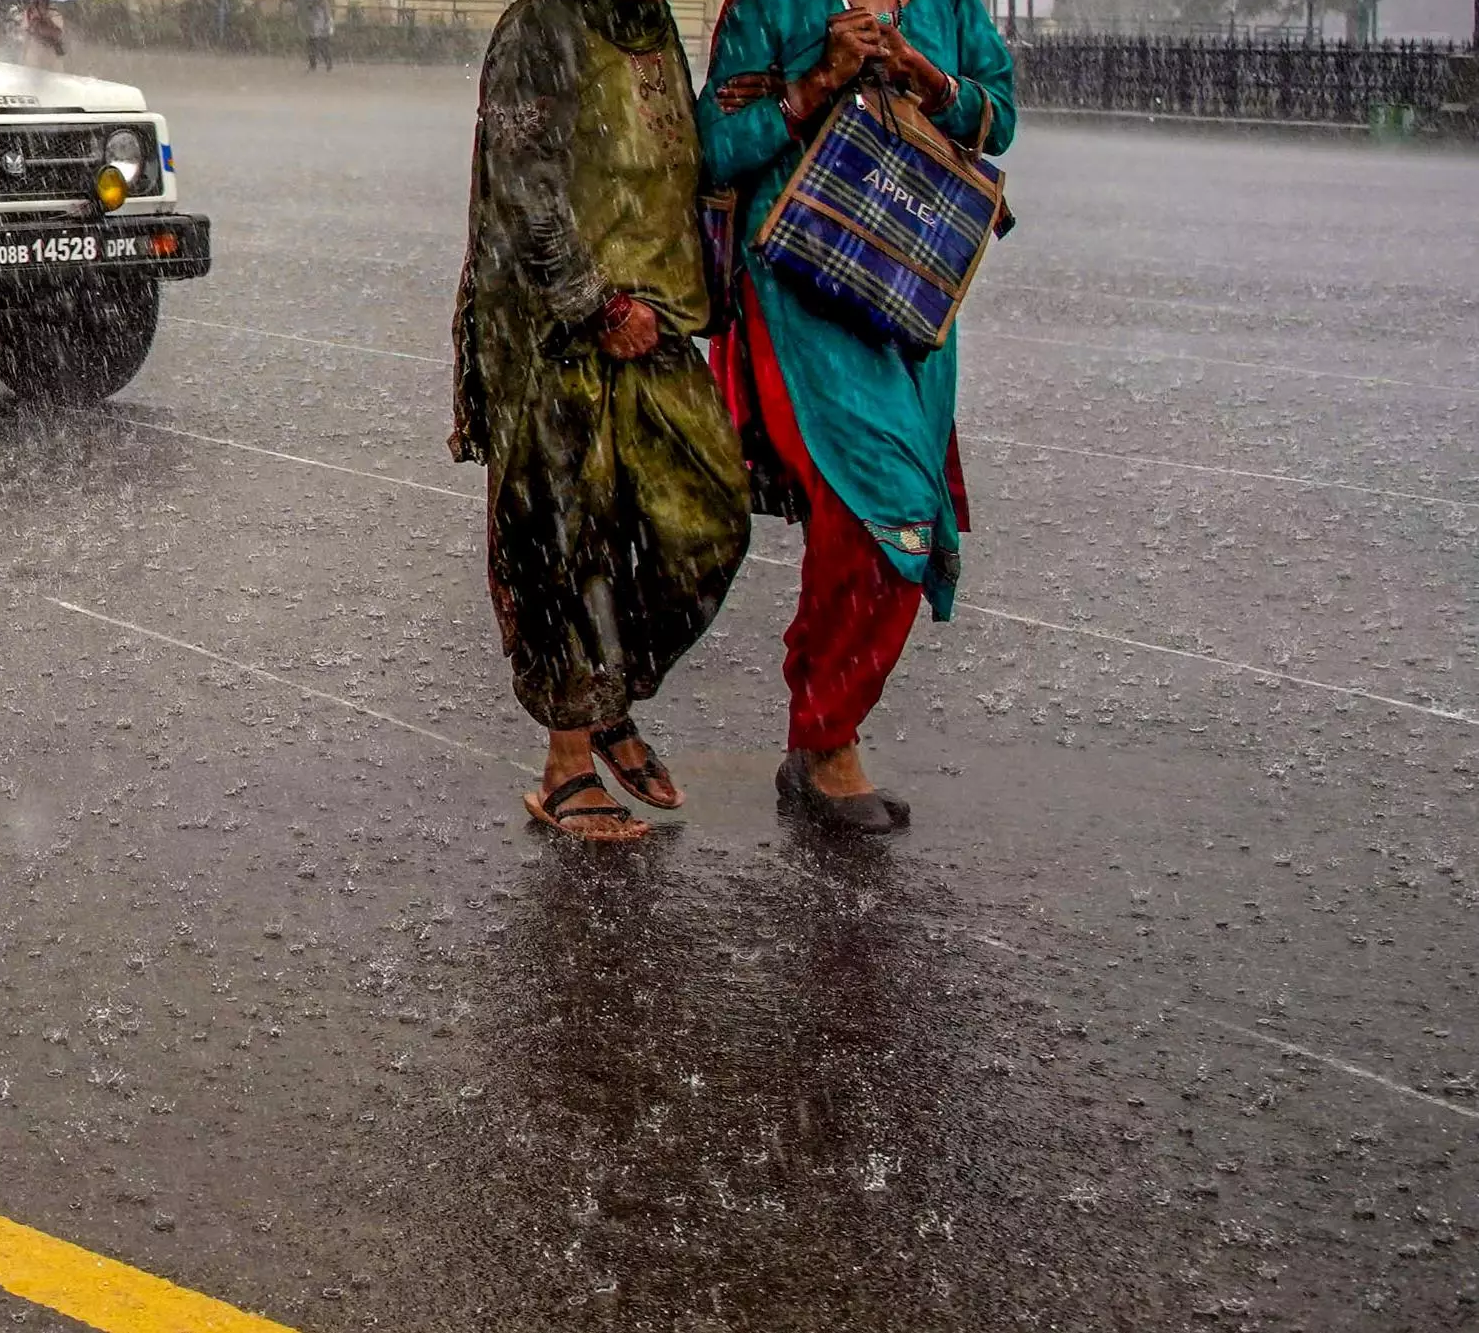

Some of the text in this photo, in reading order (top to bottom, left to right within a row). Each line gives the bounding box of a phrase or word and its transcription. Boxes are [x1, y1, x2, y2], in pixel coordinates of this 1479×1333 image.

[862, 168, 934, 227] APPLE
[32, 236, 97, 262] 14528
[107, 238, 137, 258] DPK
